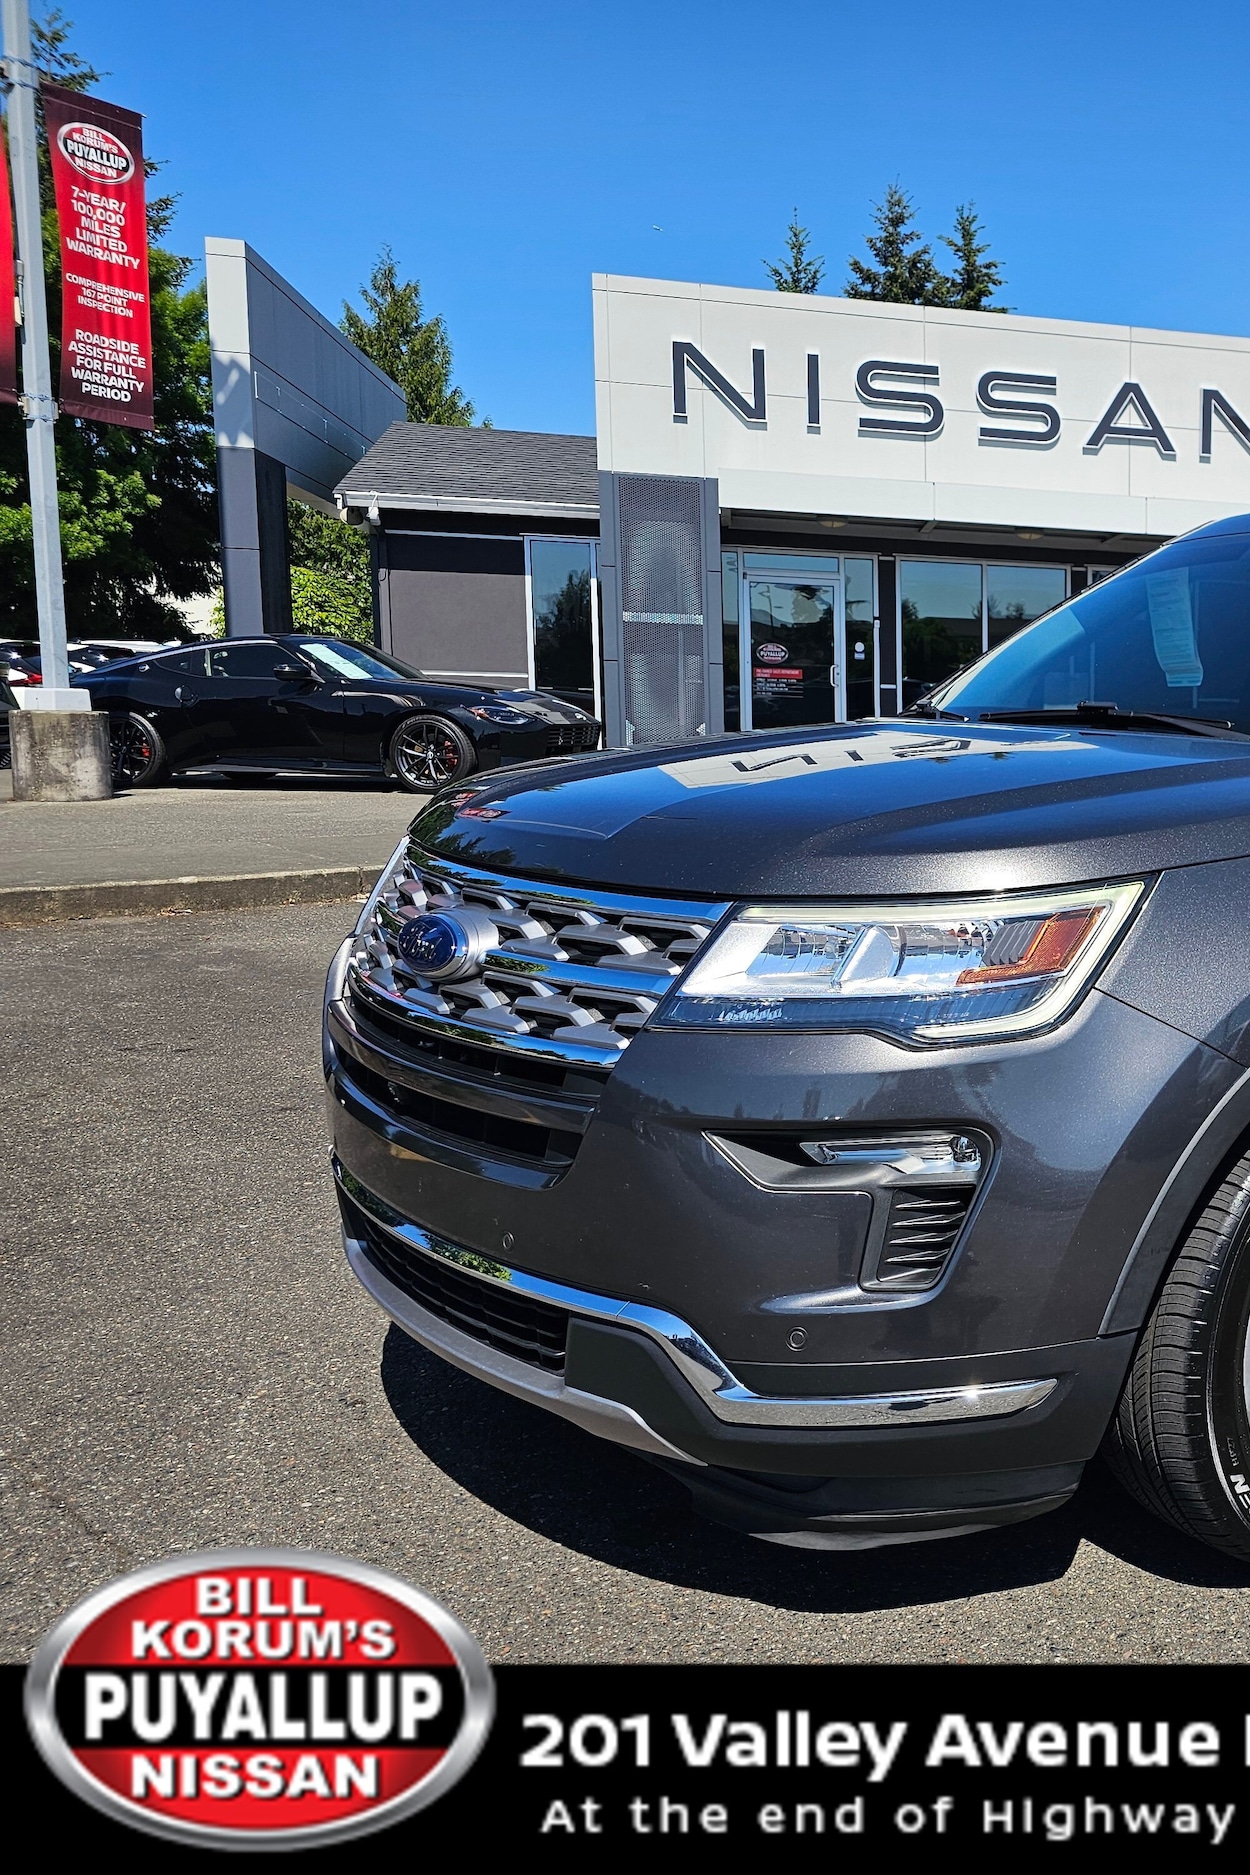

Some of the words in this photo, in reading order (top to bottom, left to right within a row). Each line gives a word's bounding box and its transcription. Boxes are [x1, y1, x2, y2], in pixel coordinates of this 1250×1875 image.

[72, 132, 118, 153] KORUM'S
[82, 127, 106, 142] BILL
[66, 139, 127, 170] PUYALLUP
[74, 157, 117, 178] NISSAN
[71, 185, 126, 214] 7-YEAR/
[71, 199, 125, 227] 100,000
[76, 227, 127, 253] LIMITED
[81, 216, 121, 238] MILES
[66, 237, 140, 269] WARRANTY
[66, 273, 145, 303] COMPREHENSIVE
[81, 287, 97, 299] 167
[97, 292, 128, 307] POINT
[77, 295, 133, 318] INSPECTION
[68, 340, 146, 369] ASSISTANCE
[75, 328, 139, 355] ROADSIDE
[71, 366, 145, 393] WARRANTY
[76, 355, 102, 372] FOR
[103, 361, 137, 380] FULL
[81, 381, 131, 403] PERIOD
